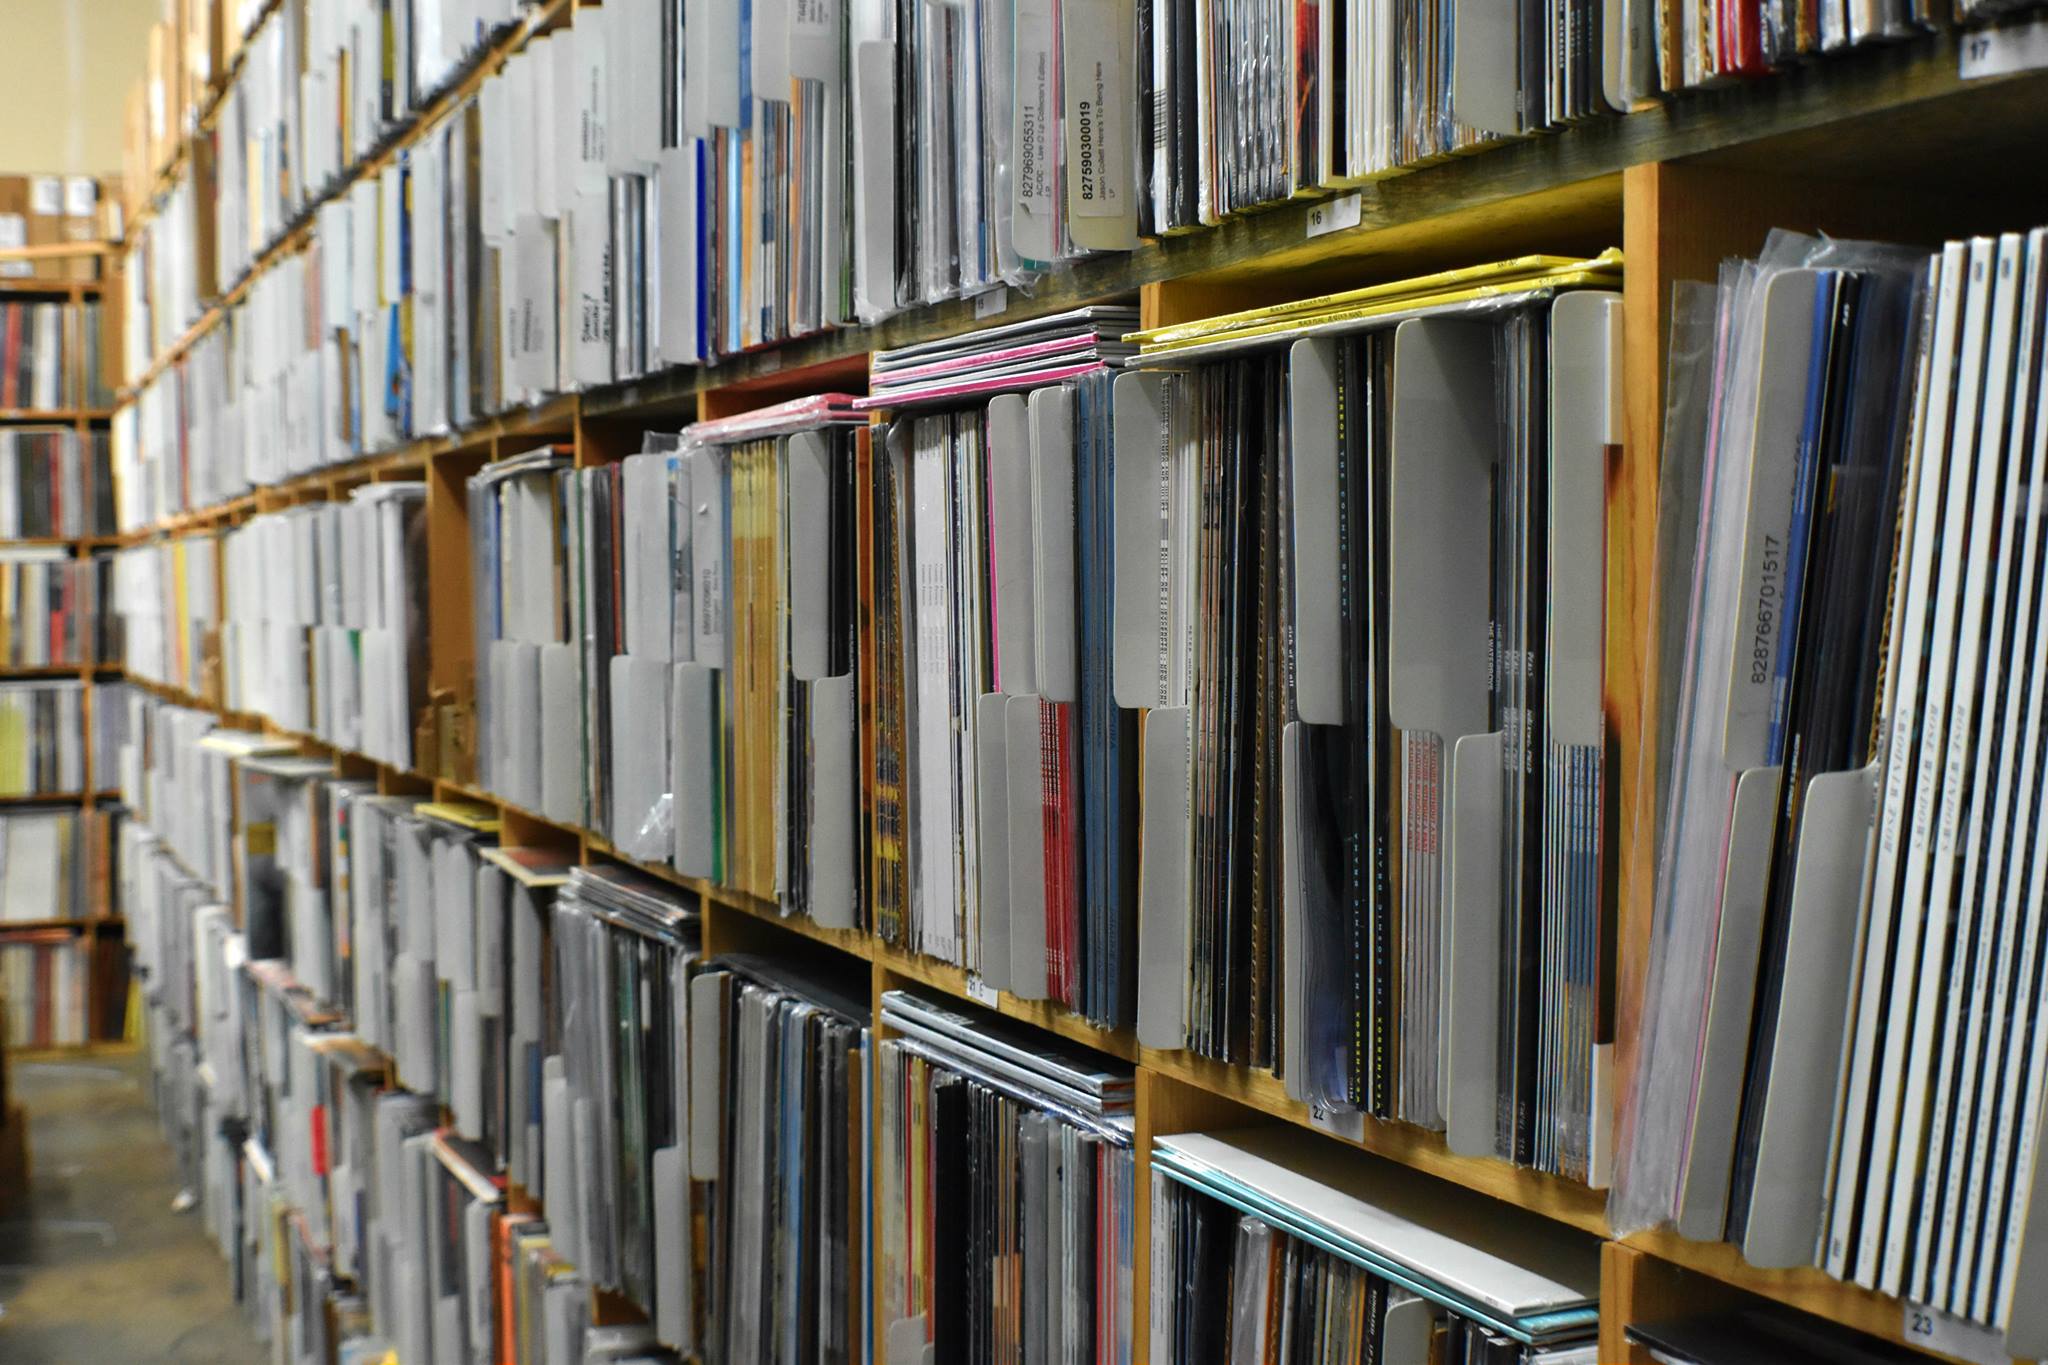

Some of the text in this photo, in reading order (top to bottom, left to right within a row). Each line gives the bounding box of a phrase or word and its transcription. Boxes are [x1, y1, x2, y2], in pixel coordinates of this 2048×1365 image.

[1970, 40, 1989, 60] 17
[1096, 82, 1104, 106] Being
[1096, 108, 1104, 120] To
[1022, 105, 1034, 198] 827969055311
[1080, 102, 1093, 200] 827590300019
[1098, 176, 1106, 200] Jason
[1109, 189, 1115, 198] LP
[1311, 210, 1322, 225] 16
[1751, 534, 1779, 684] 828766701517
[1884, 708, 1906, 851] ROSE WINDOWS
[1313, 1105, 1324, 1120] 22
[1912, 1314, 1933, 1336] 23
